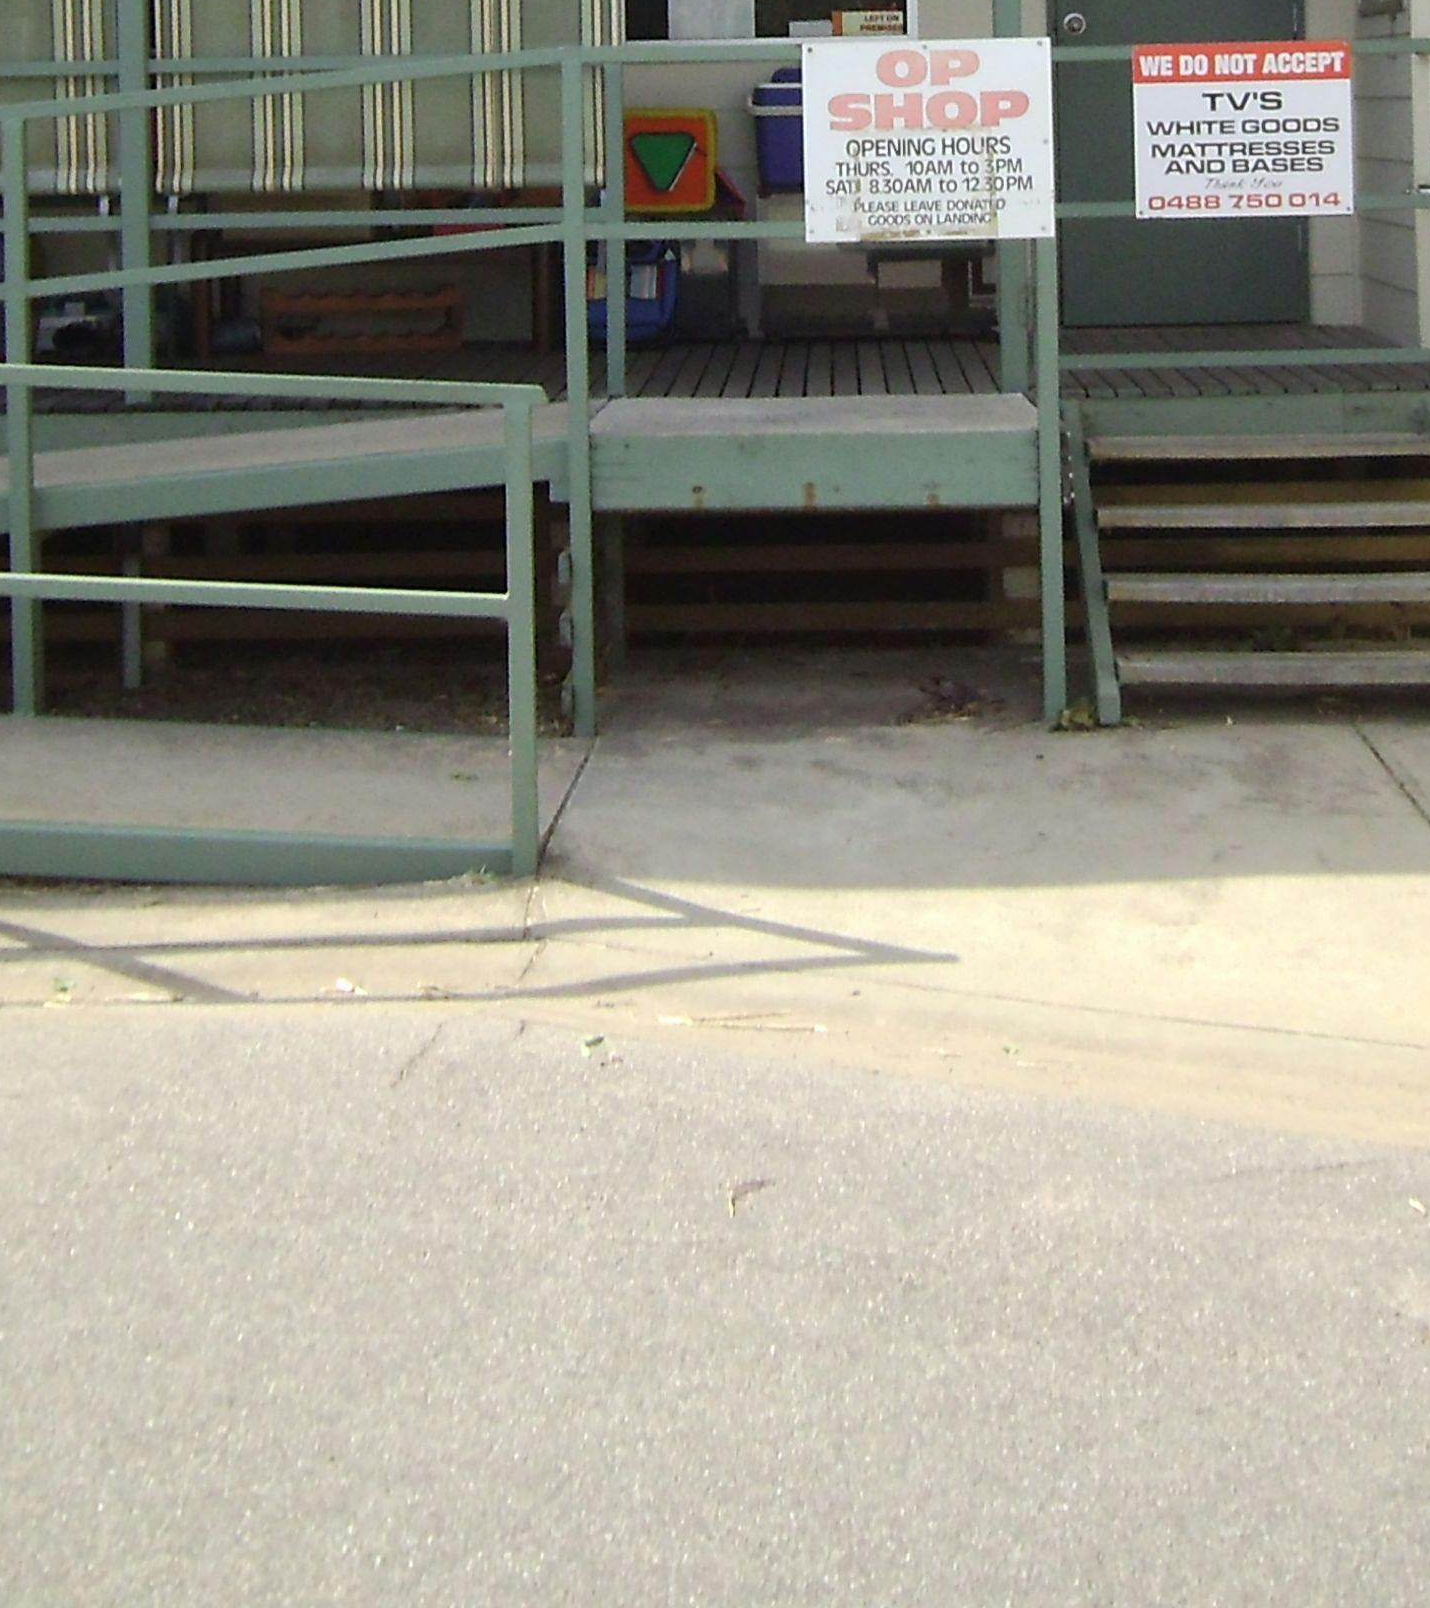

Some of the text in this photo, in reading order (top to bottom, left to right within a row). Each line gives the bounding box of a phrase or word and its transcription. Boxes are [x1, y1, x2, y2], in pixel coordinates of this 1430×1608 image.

[876, 49, 980, 87] OP
[1139, 51, 1345, 76] WE DO NOT ACCEPT
[1202, 92, 1283, 111] TV'S
[827, 91, 1030, 131] SHOP
[1147, 117, 1340, 135] WHITE GOODS
[846, 136, 1011, 157] OPENING HOURS
[1151, 141, 1335, 158] MATTRESSES
[905, 160, 953, 175] 10AM
[961, 160, 980, 175] to
[984, 158, 1023, 175] 3PM
[1165, 157, 1324, 174] AND BASES
[938, 179, 958, 193] to
[854, 198, 899, 213] PLEASE
[903, 200, 942, 212] LEAVE
[1148, 193, 1341, 210] 0488 750 014
[868, 214, 911, 226] GOODS
[914, 213, 933, 225] ON
